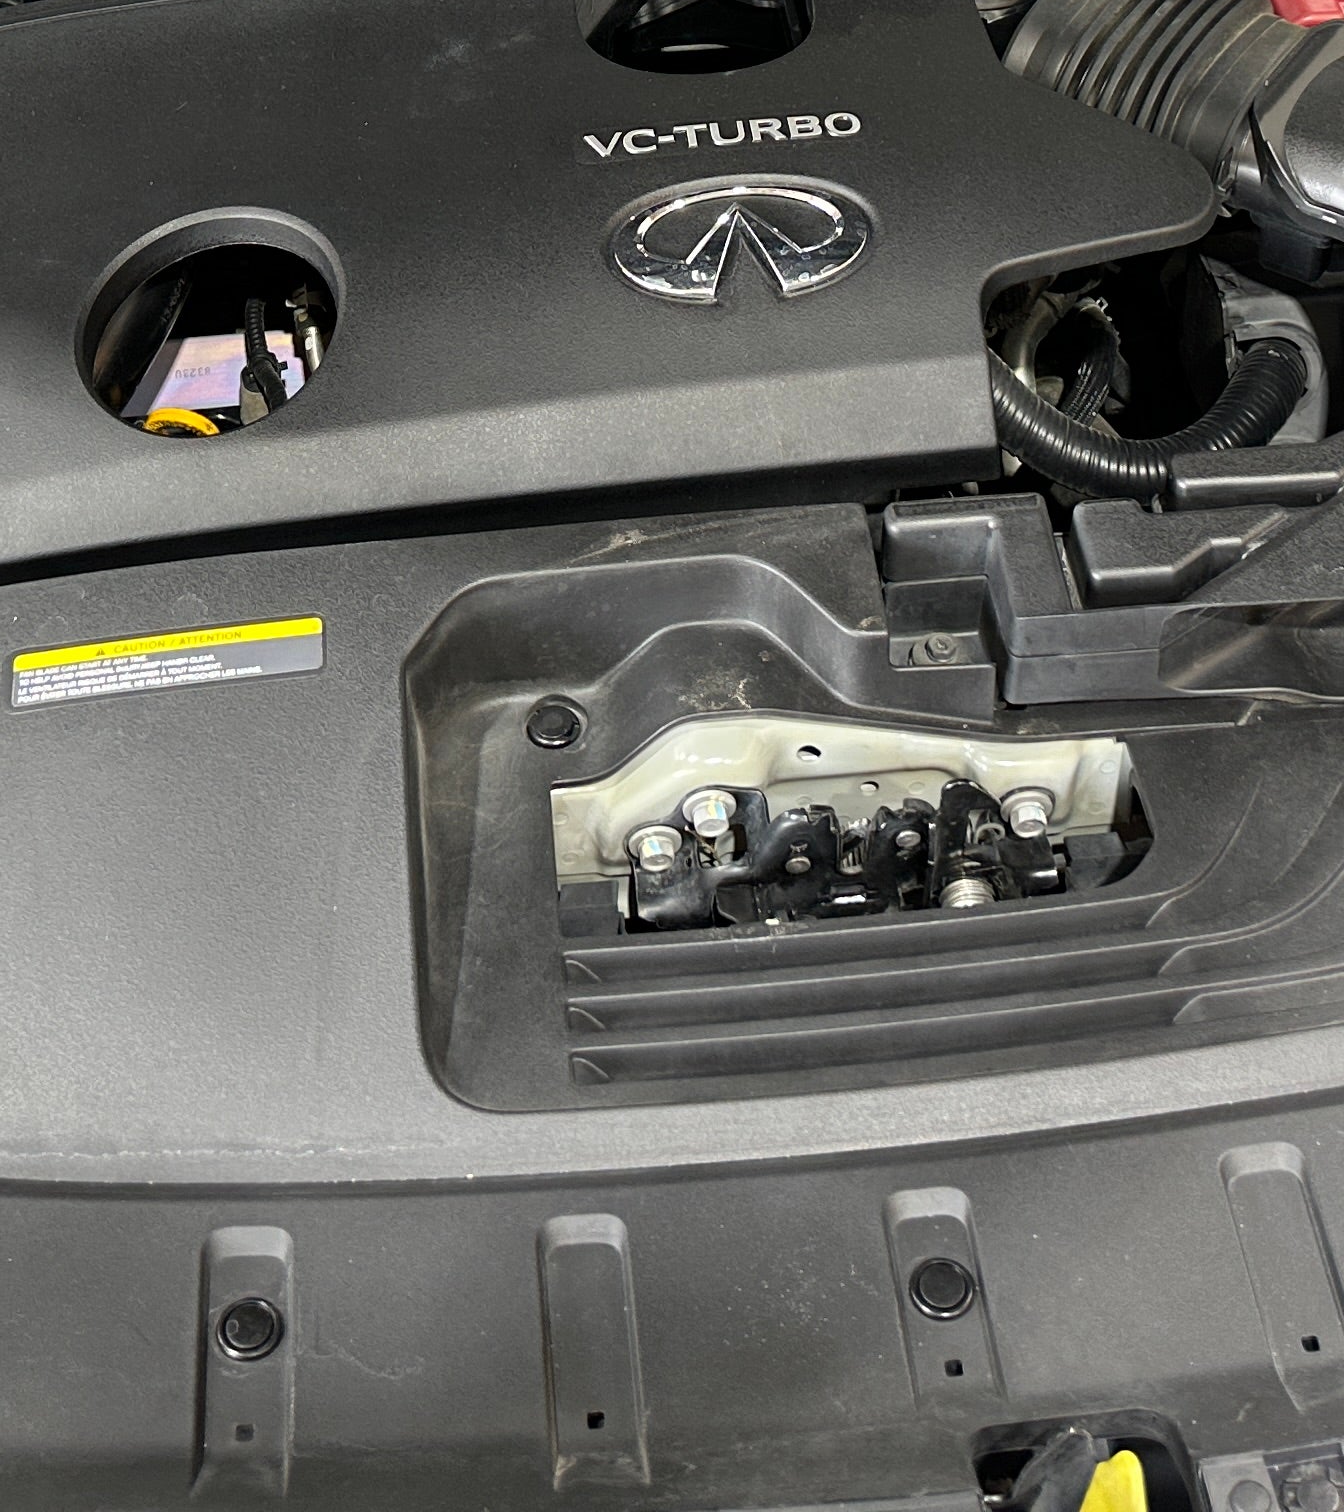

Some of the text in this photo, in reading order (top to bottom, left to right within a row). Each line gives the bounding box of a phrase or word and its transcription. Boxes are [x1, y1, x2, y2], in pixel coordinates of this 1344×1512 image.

[583, 111, 862, 158] VC-TURBO
[114, 640, 164, 653] CAUTION
[179, 630, 241, 645] ATTENTION
